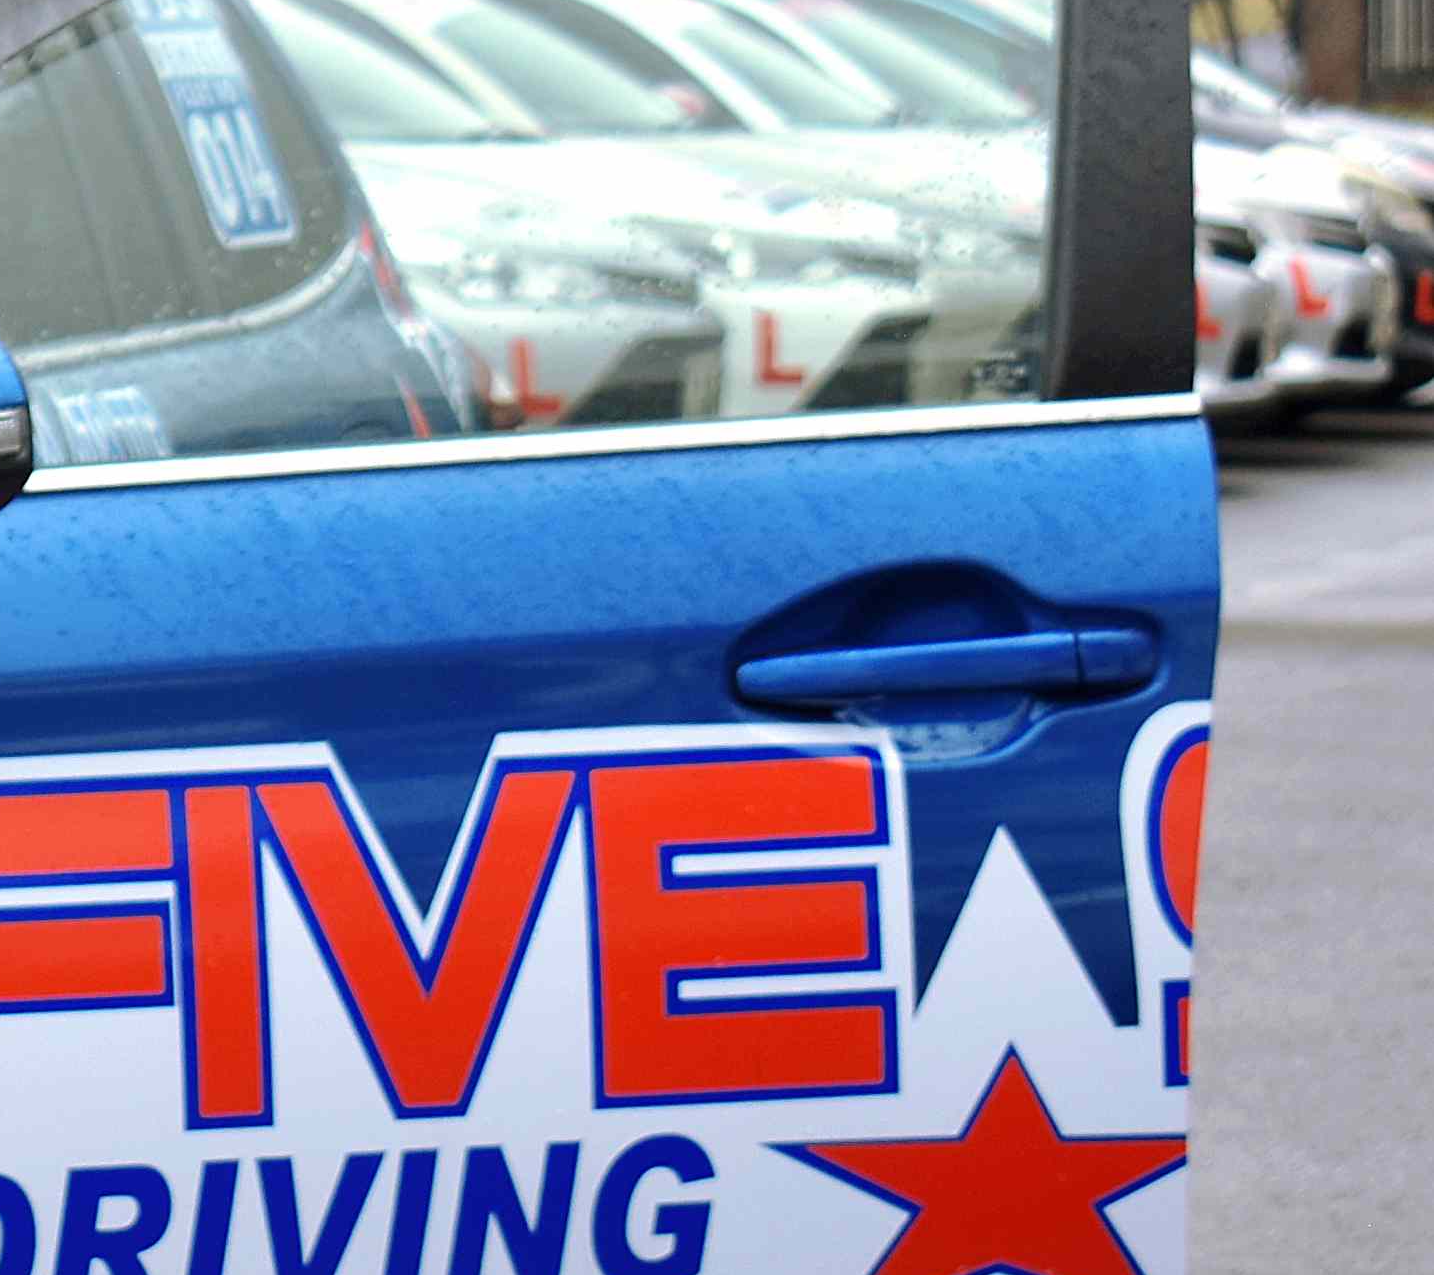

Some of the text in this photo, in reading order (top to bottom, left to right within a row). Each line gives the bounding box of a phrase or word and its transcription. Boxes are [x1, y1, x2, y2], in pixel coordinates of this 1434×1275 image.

[1289, 252, 1332, 318] L
[510, 337, 564, 416] L
[752, 311, 804, 385] L
